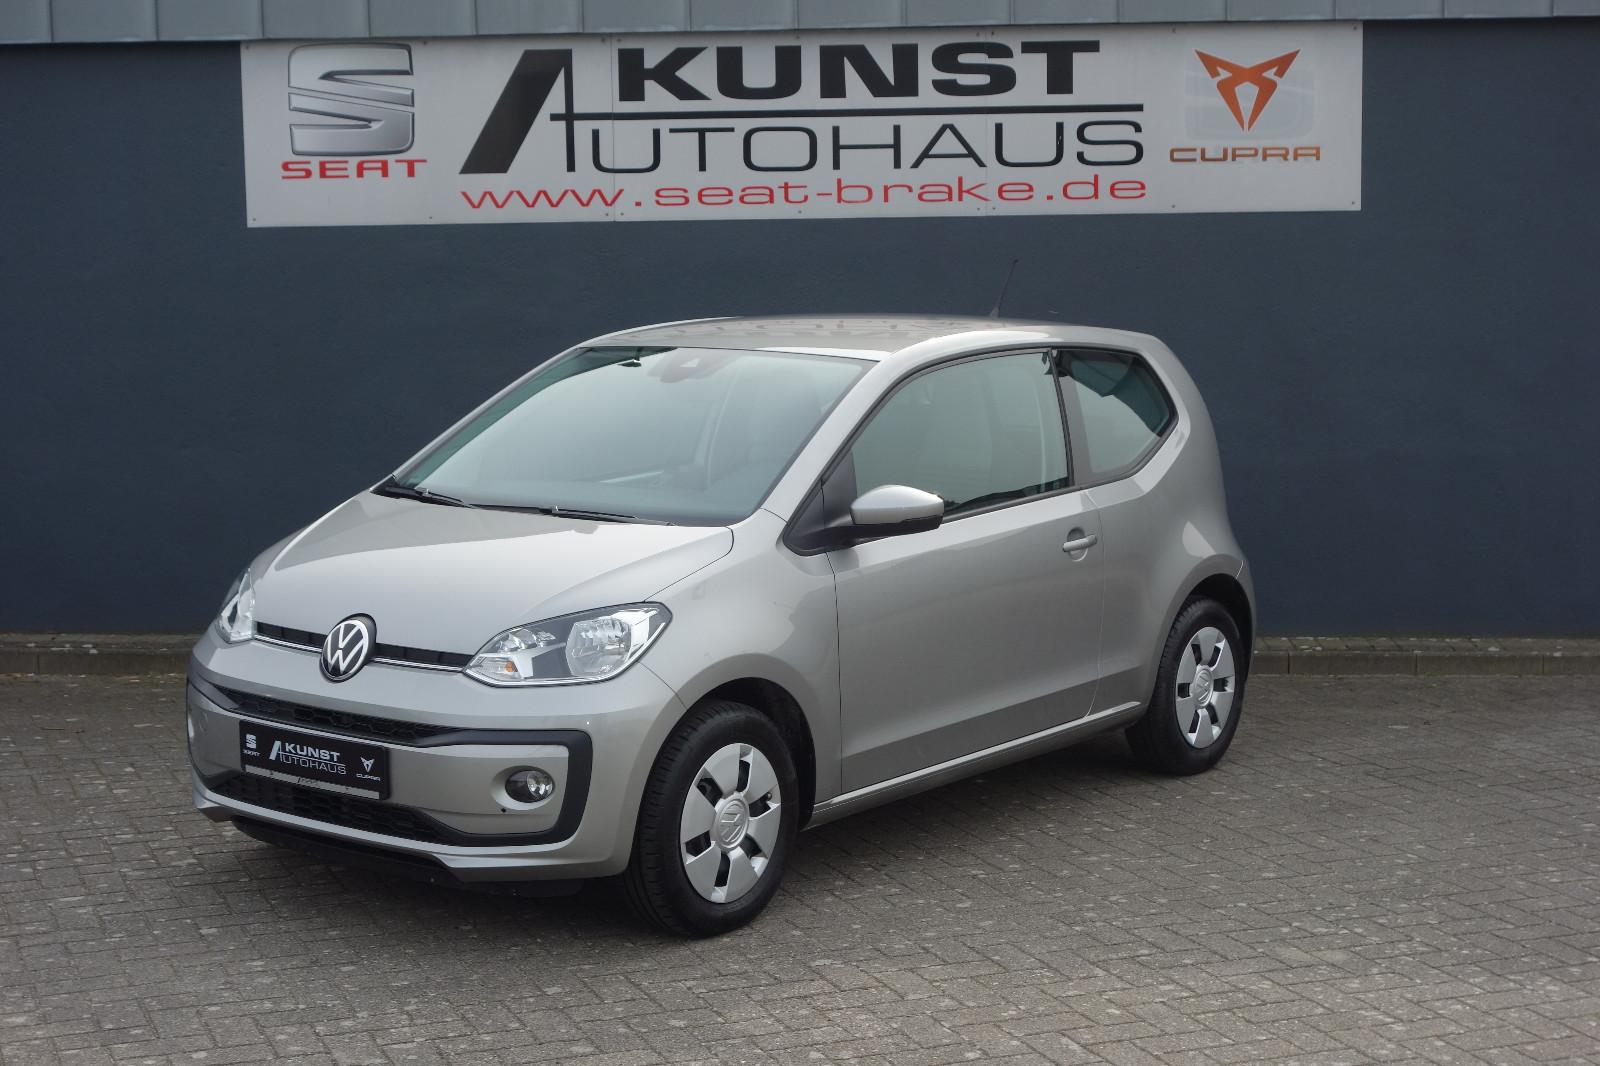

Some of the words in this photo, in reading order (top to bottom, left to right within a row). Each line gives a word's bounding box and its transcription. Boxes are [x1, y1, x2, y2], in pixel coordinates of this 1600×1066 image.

[618, 40, 1101, 102] KUNST
[459, 48, 1144, 175] AUTOHAUS
[281, 158, 428, 180] SEAT
[1169, 145, 1322, 163] CUPRA
[460, 174, 1147, 209] www.seat-brake.de
[269, 740, 346, 774] AUTOHAUS
[285, 742, 340, 762] KUNST
